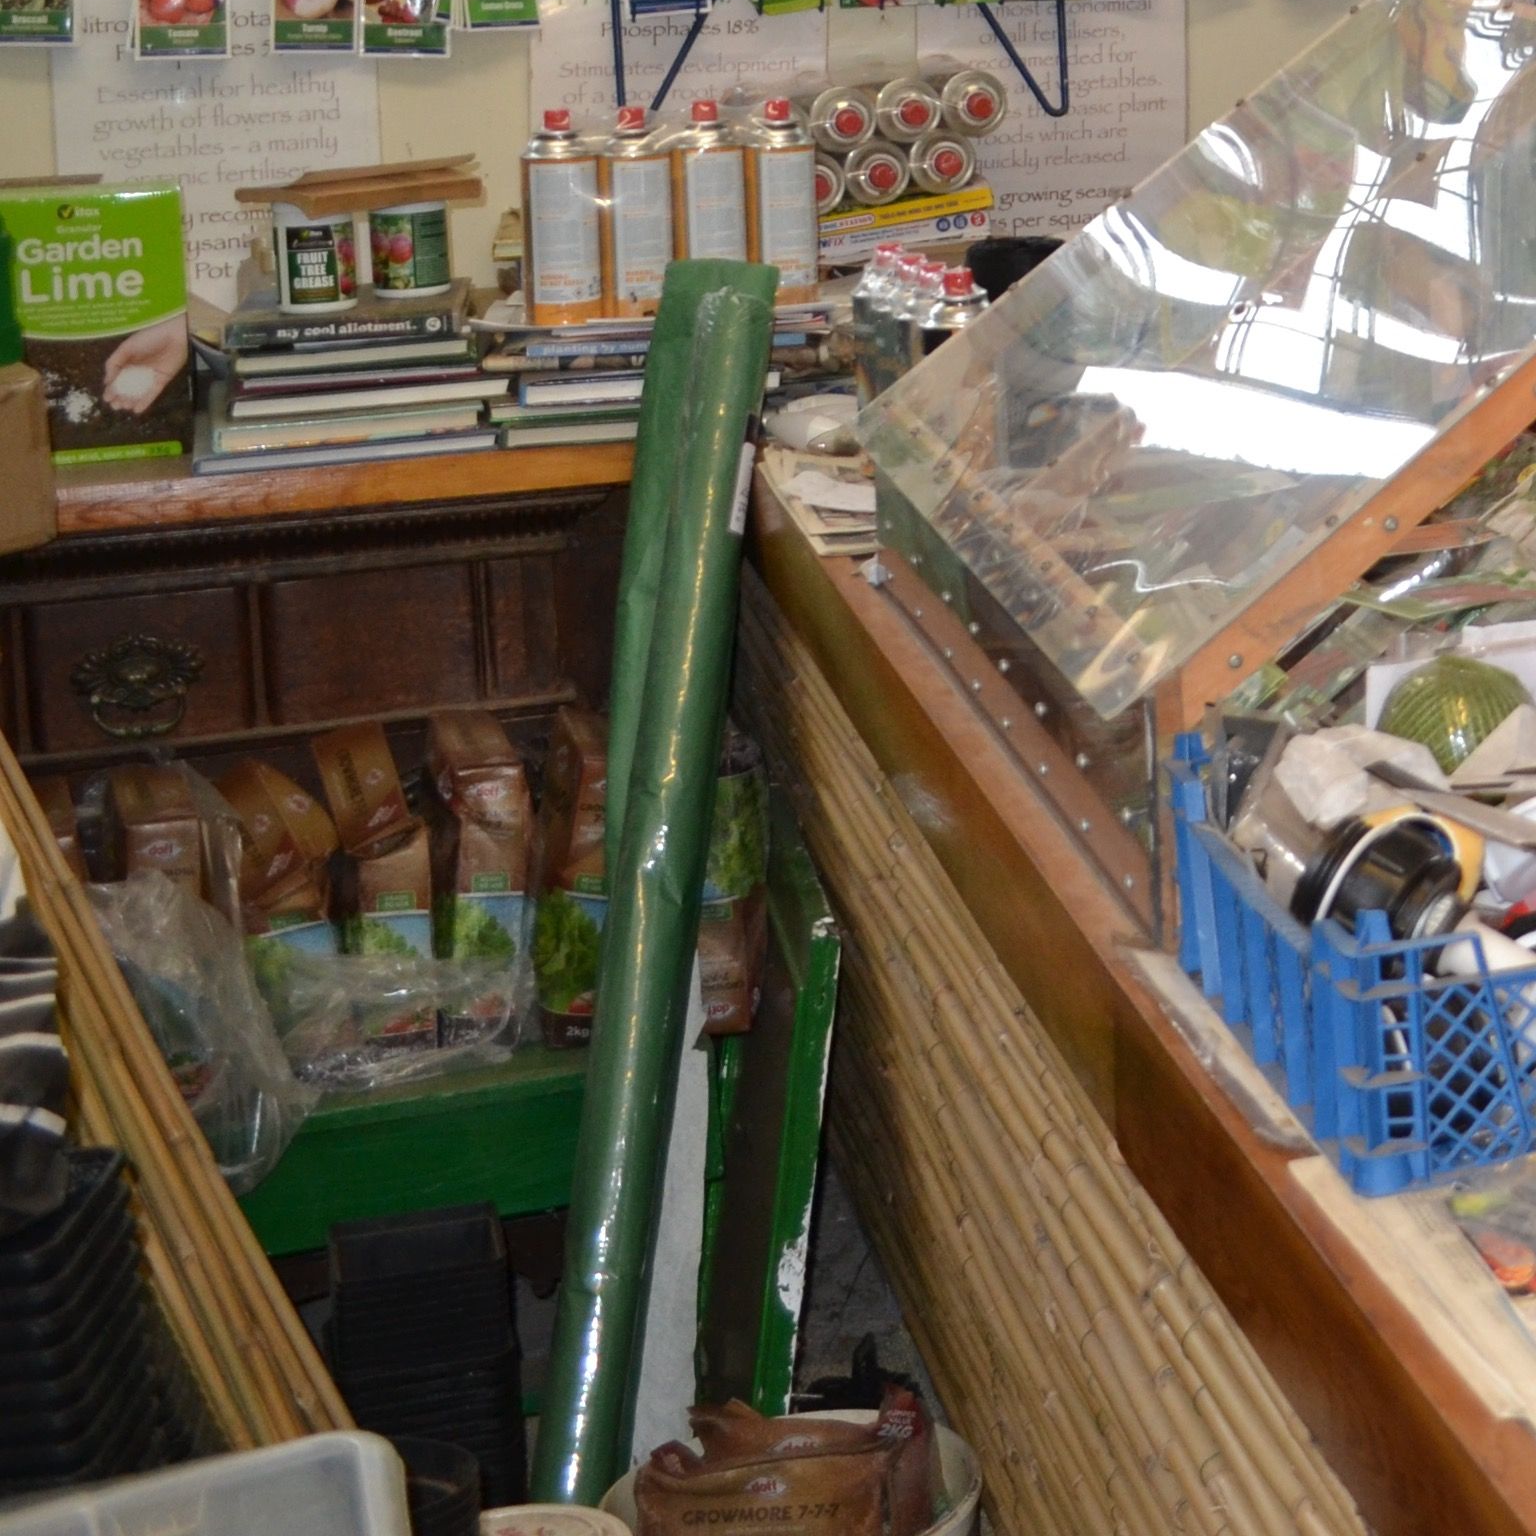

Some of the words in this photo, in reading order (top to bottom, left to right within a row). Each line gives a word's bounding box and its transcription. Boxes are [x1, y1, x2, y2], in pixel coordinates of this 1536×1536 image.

[726, 19, 760, 37] 18%
[209, 76, 246, 100] for
[250, 70, 336, 102] healthy
[1119, 95, 1168, 120] plant
[93, 106, 175, 141] growth
[180, 104, 208, 130] of
[213, 101, 292, 128] flowers
[296, 98, 342, 122] and
[1039, 120, 1093, 141] which
[1097, 125, 1128, 140] are
[100, 134, 224, 169] vegetables
[267, 128, 339, 160] mainly
[999, 187, 1073, 208] growing
[1013, 212, 1044, 230] per
[16, 235, 144, 264] Garden
[295, 250, 329, 264] FRUIT
[299, 263, 328, 278] TREE
[19, 266, 145, 303] Lime
[293, 275, 335, 290] GREASE
[276, 326, 301, 340] my
[303, 322, 336, 337] cool
[683, 1503, 792, 1523] GROWMORE
